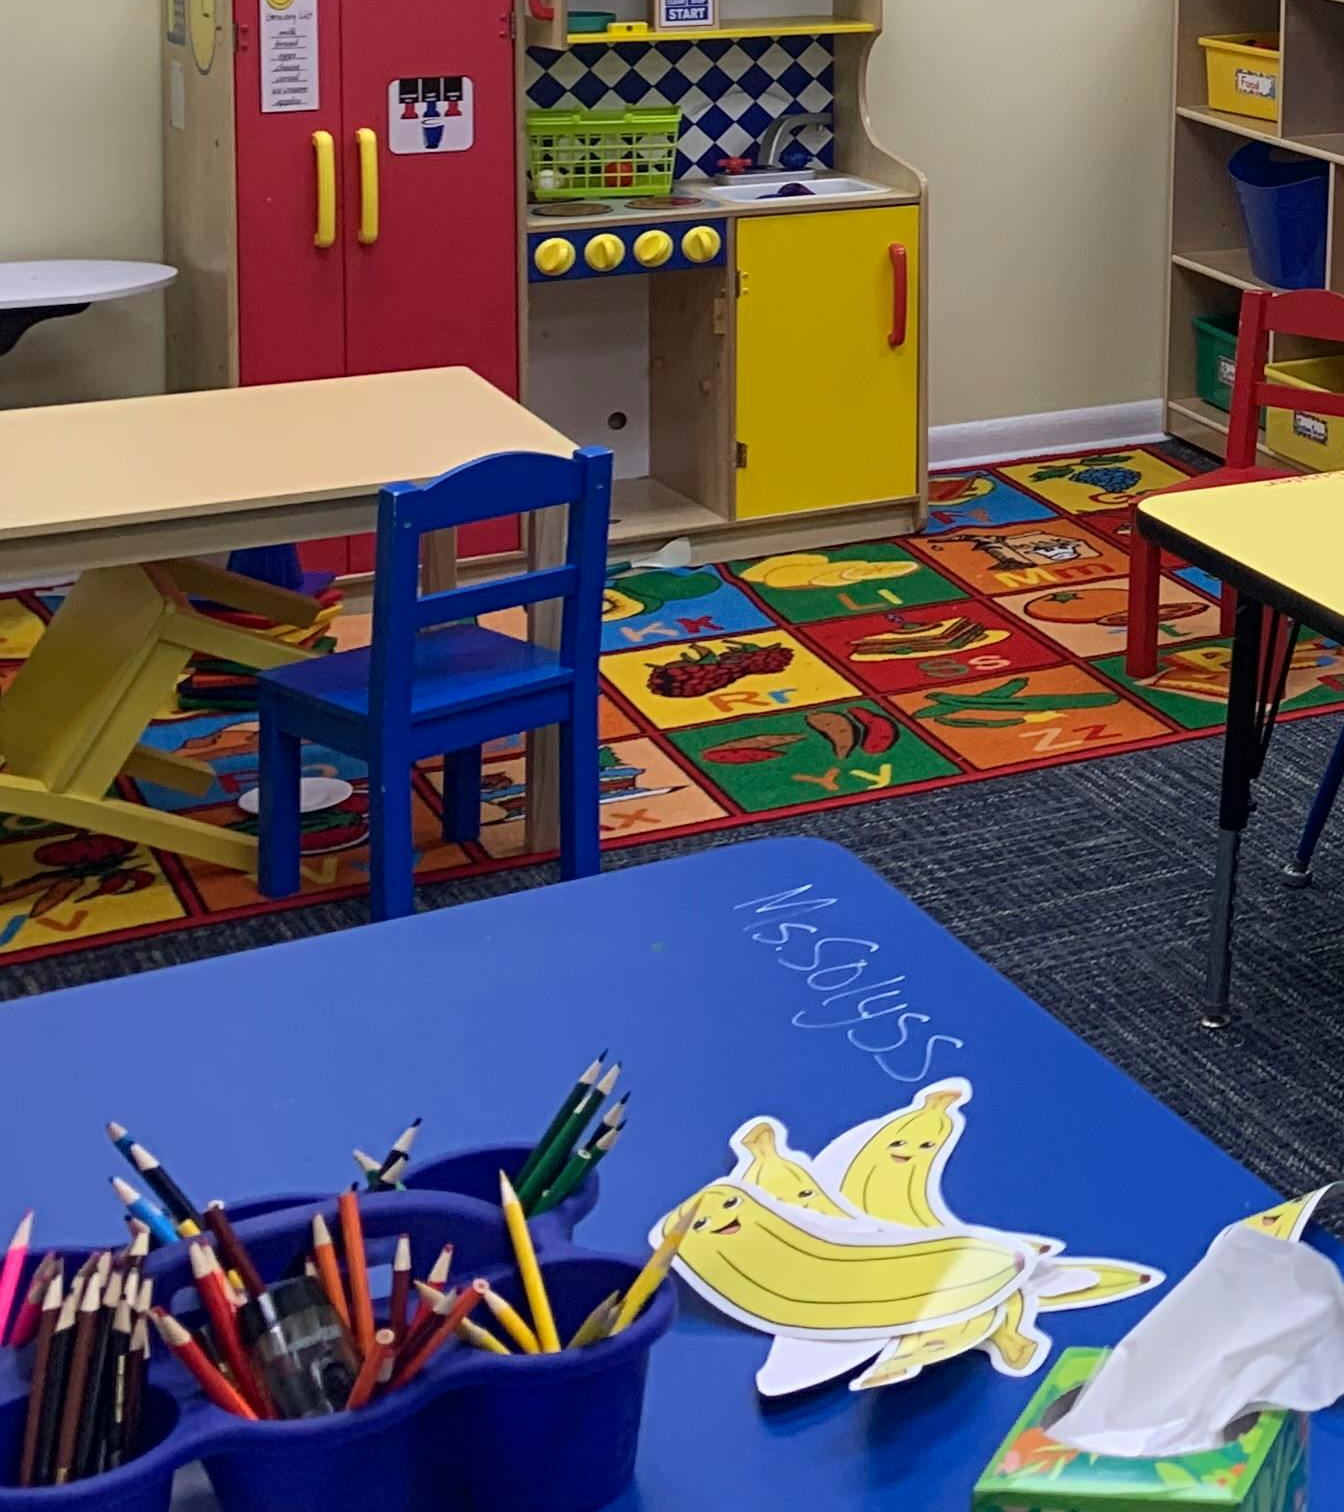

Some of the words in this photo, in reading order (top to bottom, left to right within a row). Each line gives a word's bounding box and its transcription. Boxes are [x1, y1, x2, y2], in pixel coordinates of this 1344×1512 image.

[668, 7, 706, 21] START
[994, 562, 1116, 588] Mm
[708, 688, 798, 713] Rr
[1018, 724, 1122, 753] Zz
[791, 763, 892, 790] Yy
